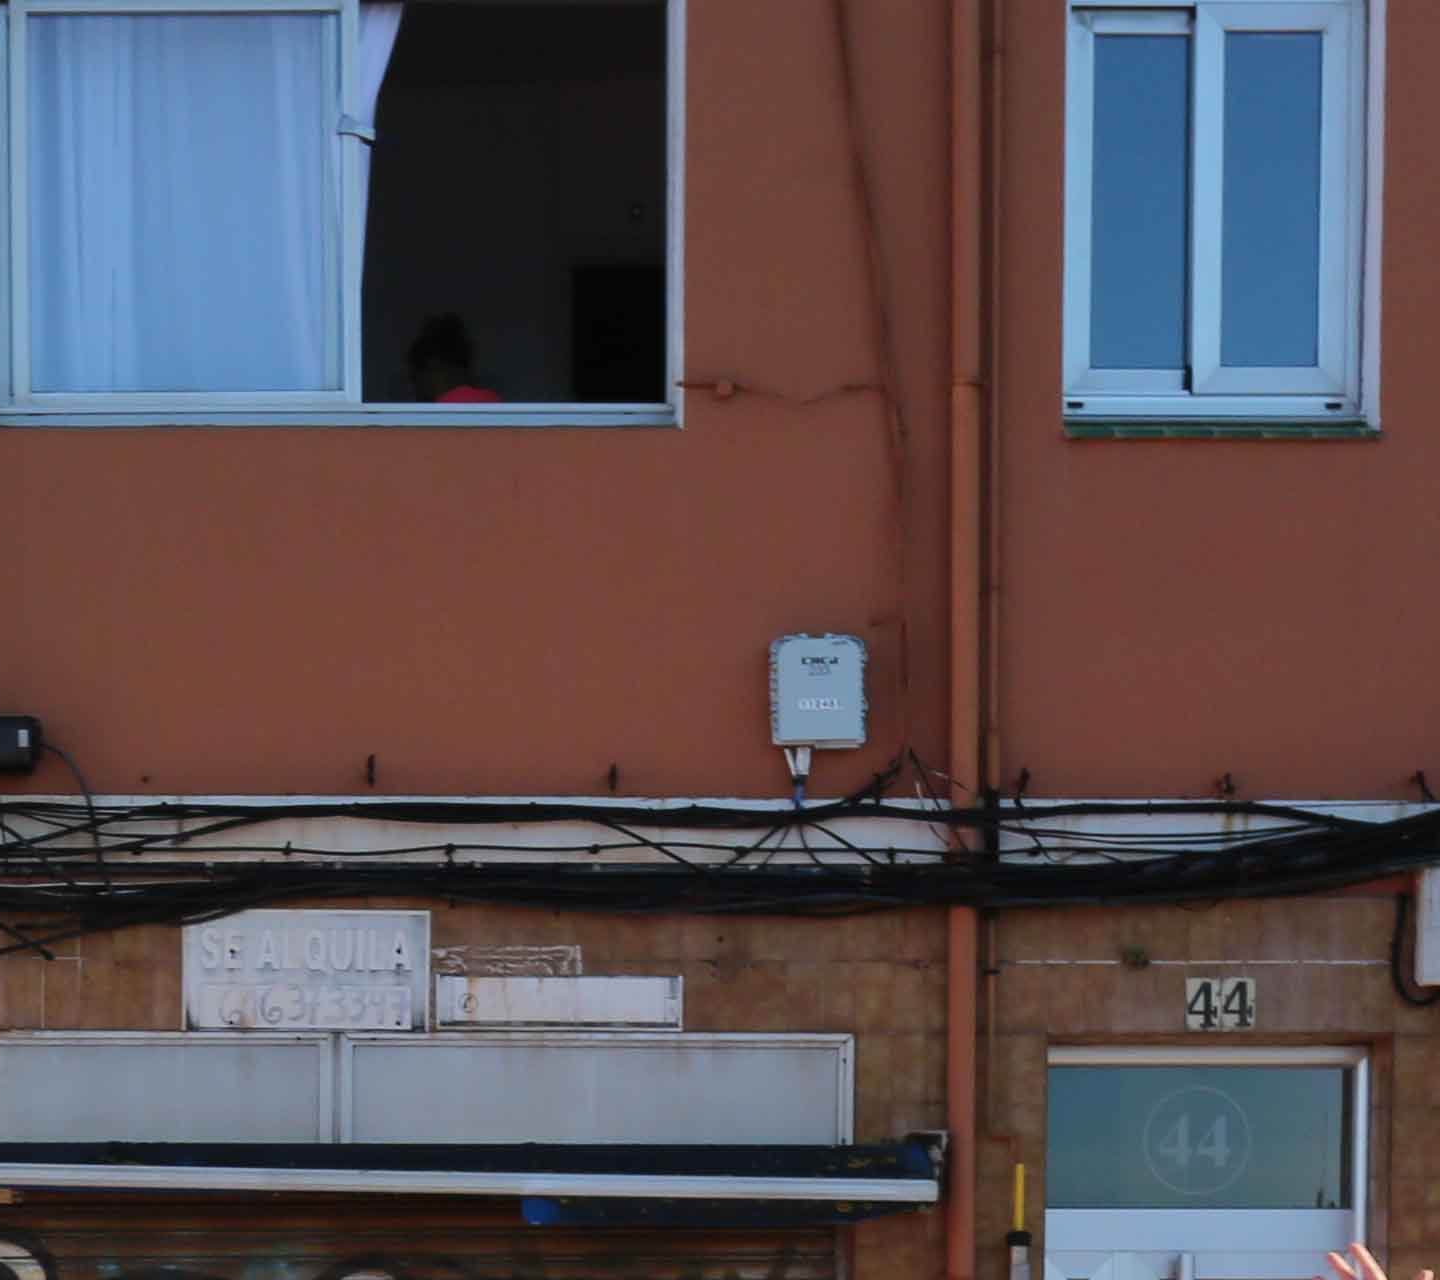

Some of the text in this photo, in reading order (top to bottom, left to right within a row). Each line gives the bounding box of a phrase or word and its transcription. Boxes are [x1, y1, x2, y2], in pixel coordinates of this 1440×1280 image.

[200, 928, 242, 970] SE
[1187, 981, 1253, 1029] 44
[1160, 1114, 1232, 1168] 44
